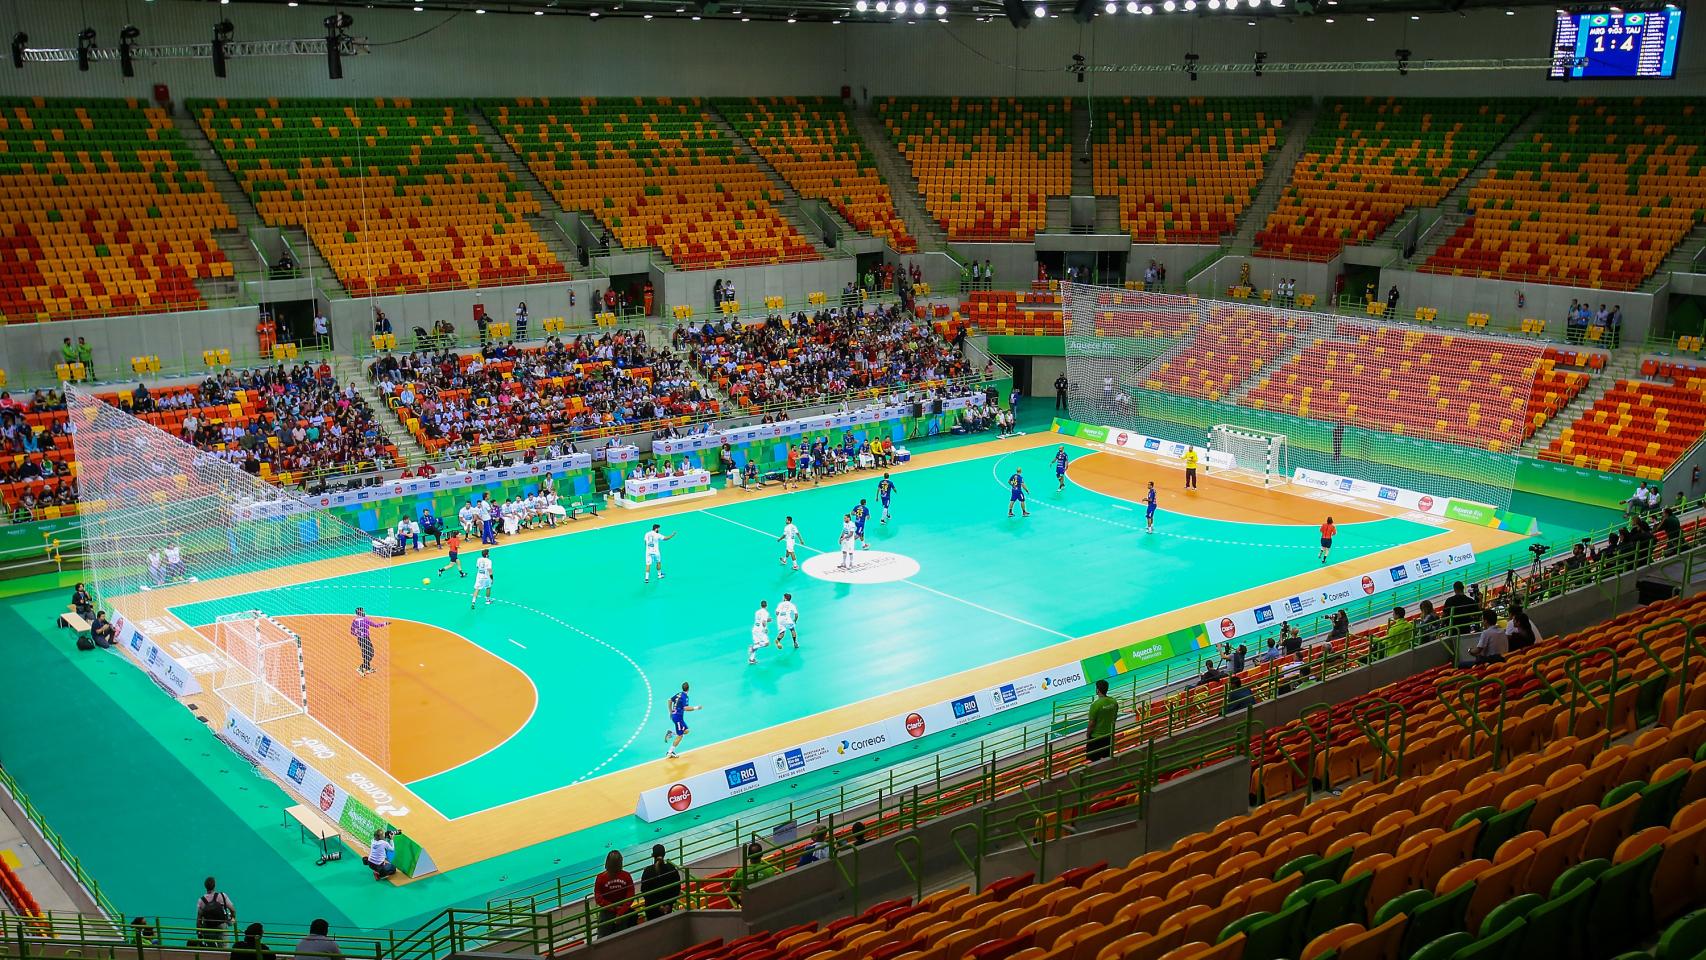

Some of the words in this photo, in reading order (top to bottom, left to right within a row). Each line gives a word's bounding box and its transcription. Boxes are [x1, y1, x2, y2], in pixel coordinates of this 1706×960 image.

[1626, 26, 1640, 34] TAU
[1594, 36, 1604, 52] 1
[1620, 35, 1633, 51] 4
[1329, 590, 1350, 601] Correios
[1133, 648, 1153, 658] Aquece
[1053, 674, 1081, 687] Correios
[964, 701, 976, 711] RIO
[907, 720, 922, 731] Claro
[851, 734, 886, 751] Correios
[740, 768, 755, 779] RIO
[345, 772, 392, 804] Correios
[669, 791, 688, 804] Claro
